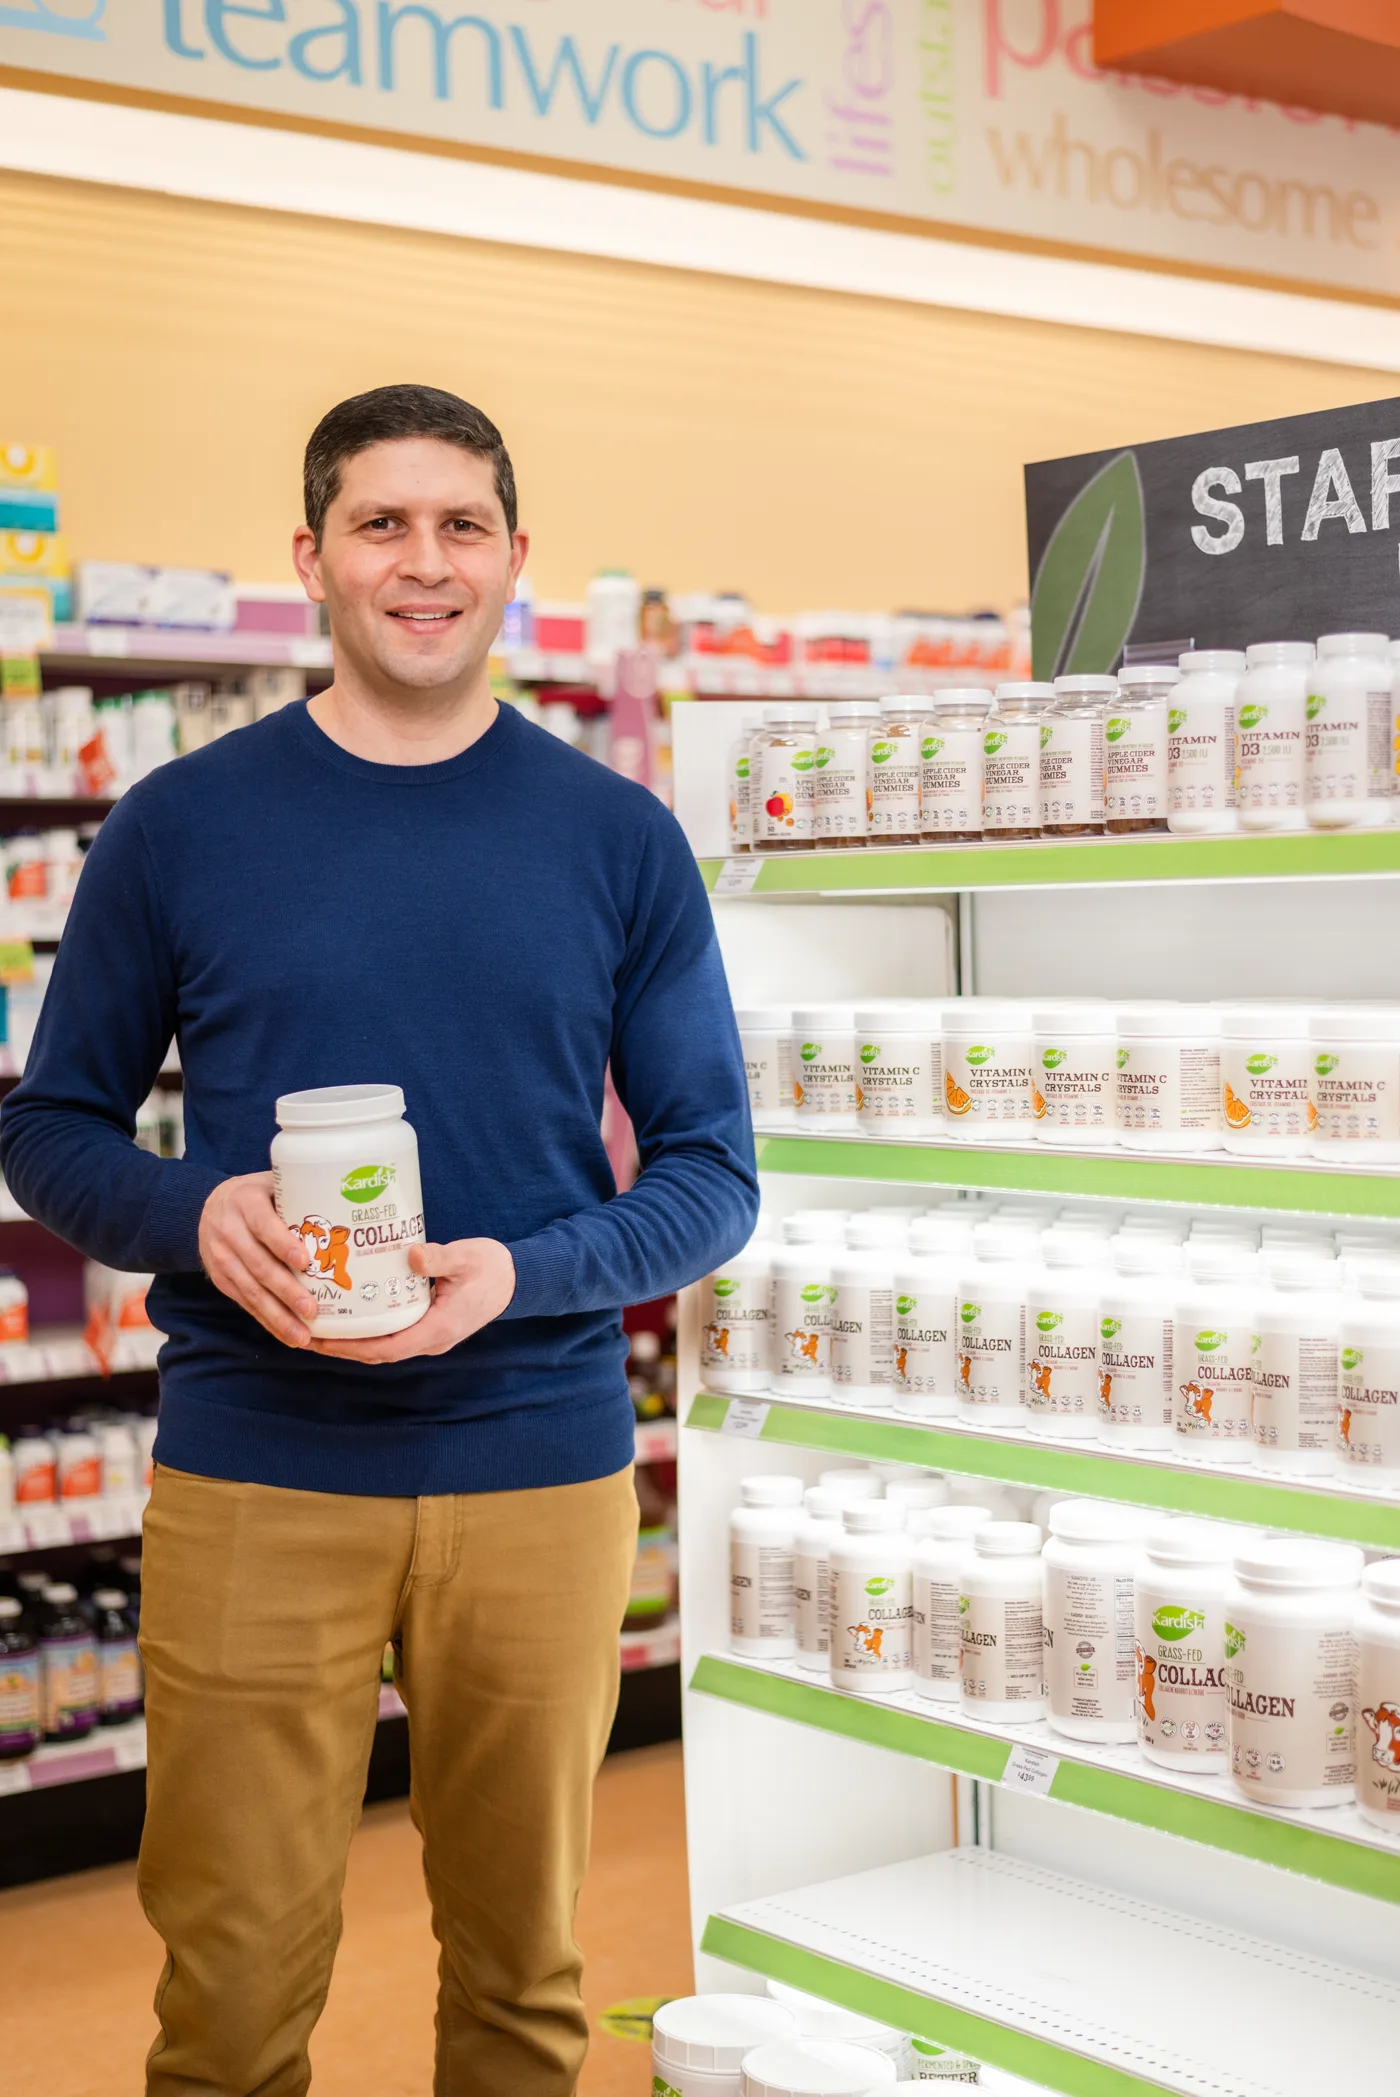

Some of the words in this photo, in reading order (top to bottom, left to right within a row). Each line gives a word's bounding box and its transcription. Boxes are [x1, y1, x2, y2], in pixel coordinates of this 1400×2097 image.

[985, 110, 1383, 252] wholesome
[1241, 731, 1300, 742] VITAMIN
[1168, 747, 1180, 760] D3
[1241, 742, 1260, 757] D3
[1108, 758, 1144, 766] VINEGAR
[1108, 764, 1149, 774] GUMMIES
[922, 780, 960, 789] GUMMIES
[986, 776, 1024, 785] GUMMIES
[874, 784, 914, 793] GUMMIES
[803, 1064, 850, 1073] VITAMIN
[862, 1066, 910, 1076] VITAMIN
[912, 1066, 920, 1075] C
[970, 1068, 1026, 1078] VITAMIN
[802, 1074, 854, 1083] CRYSTALS
[862, 1077, 913, 1086] CRYSTALS
[1045, 1072, 1098, 1082] VITAMIN
[1102, 1072, 1110, 1082] C
[1158, 1074, 1167, 1084] C
[970, 1078, 1028, 1088] CRYSTALS
[1044, 1084, 1102, 1092] CRYSTALS
[1317, 1080, 1373, 1091] VITAMIN
[1376, 1081, 1386, 1091] C
[1250, 1090, 1308, 1100] CRYSTAL
[1316, 1092, 1376, 1103] CRYSTALS
[341, 1167, 396, 1191] Kardish
[352, 1204, 397, 1222] GRASS-FED
[354, 1212, 425, 1248] COLLAGE
[716, 1310, 768, 1321] COLLAGEN
[897, 1328, 948, 1342] COLLAGEN
[1038, 1334, 1064, 1344] GRASS-FED
[962, 1336, 1012, 1351] COLLAGEN
[1038, 1344, 1096, 1360] COLLAGEN
[1102, 1352, 1155, 1369] COLLAGEN
[1198, 1354, 1228, 1364] GRASS-FED
[1198, 1366, 1252, 1381] COLLAGE
[1342, 1385, 1398, 1405] COLLAGEN
[1152, 1610, 1204, 1630] Kardish
[1158, 1644, 1202, 1662] GRASS-FED
